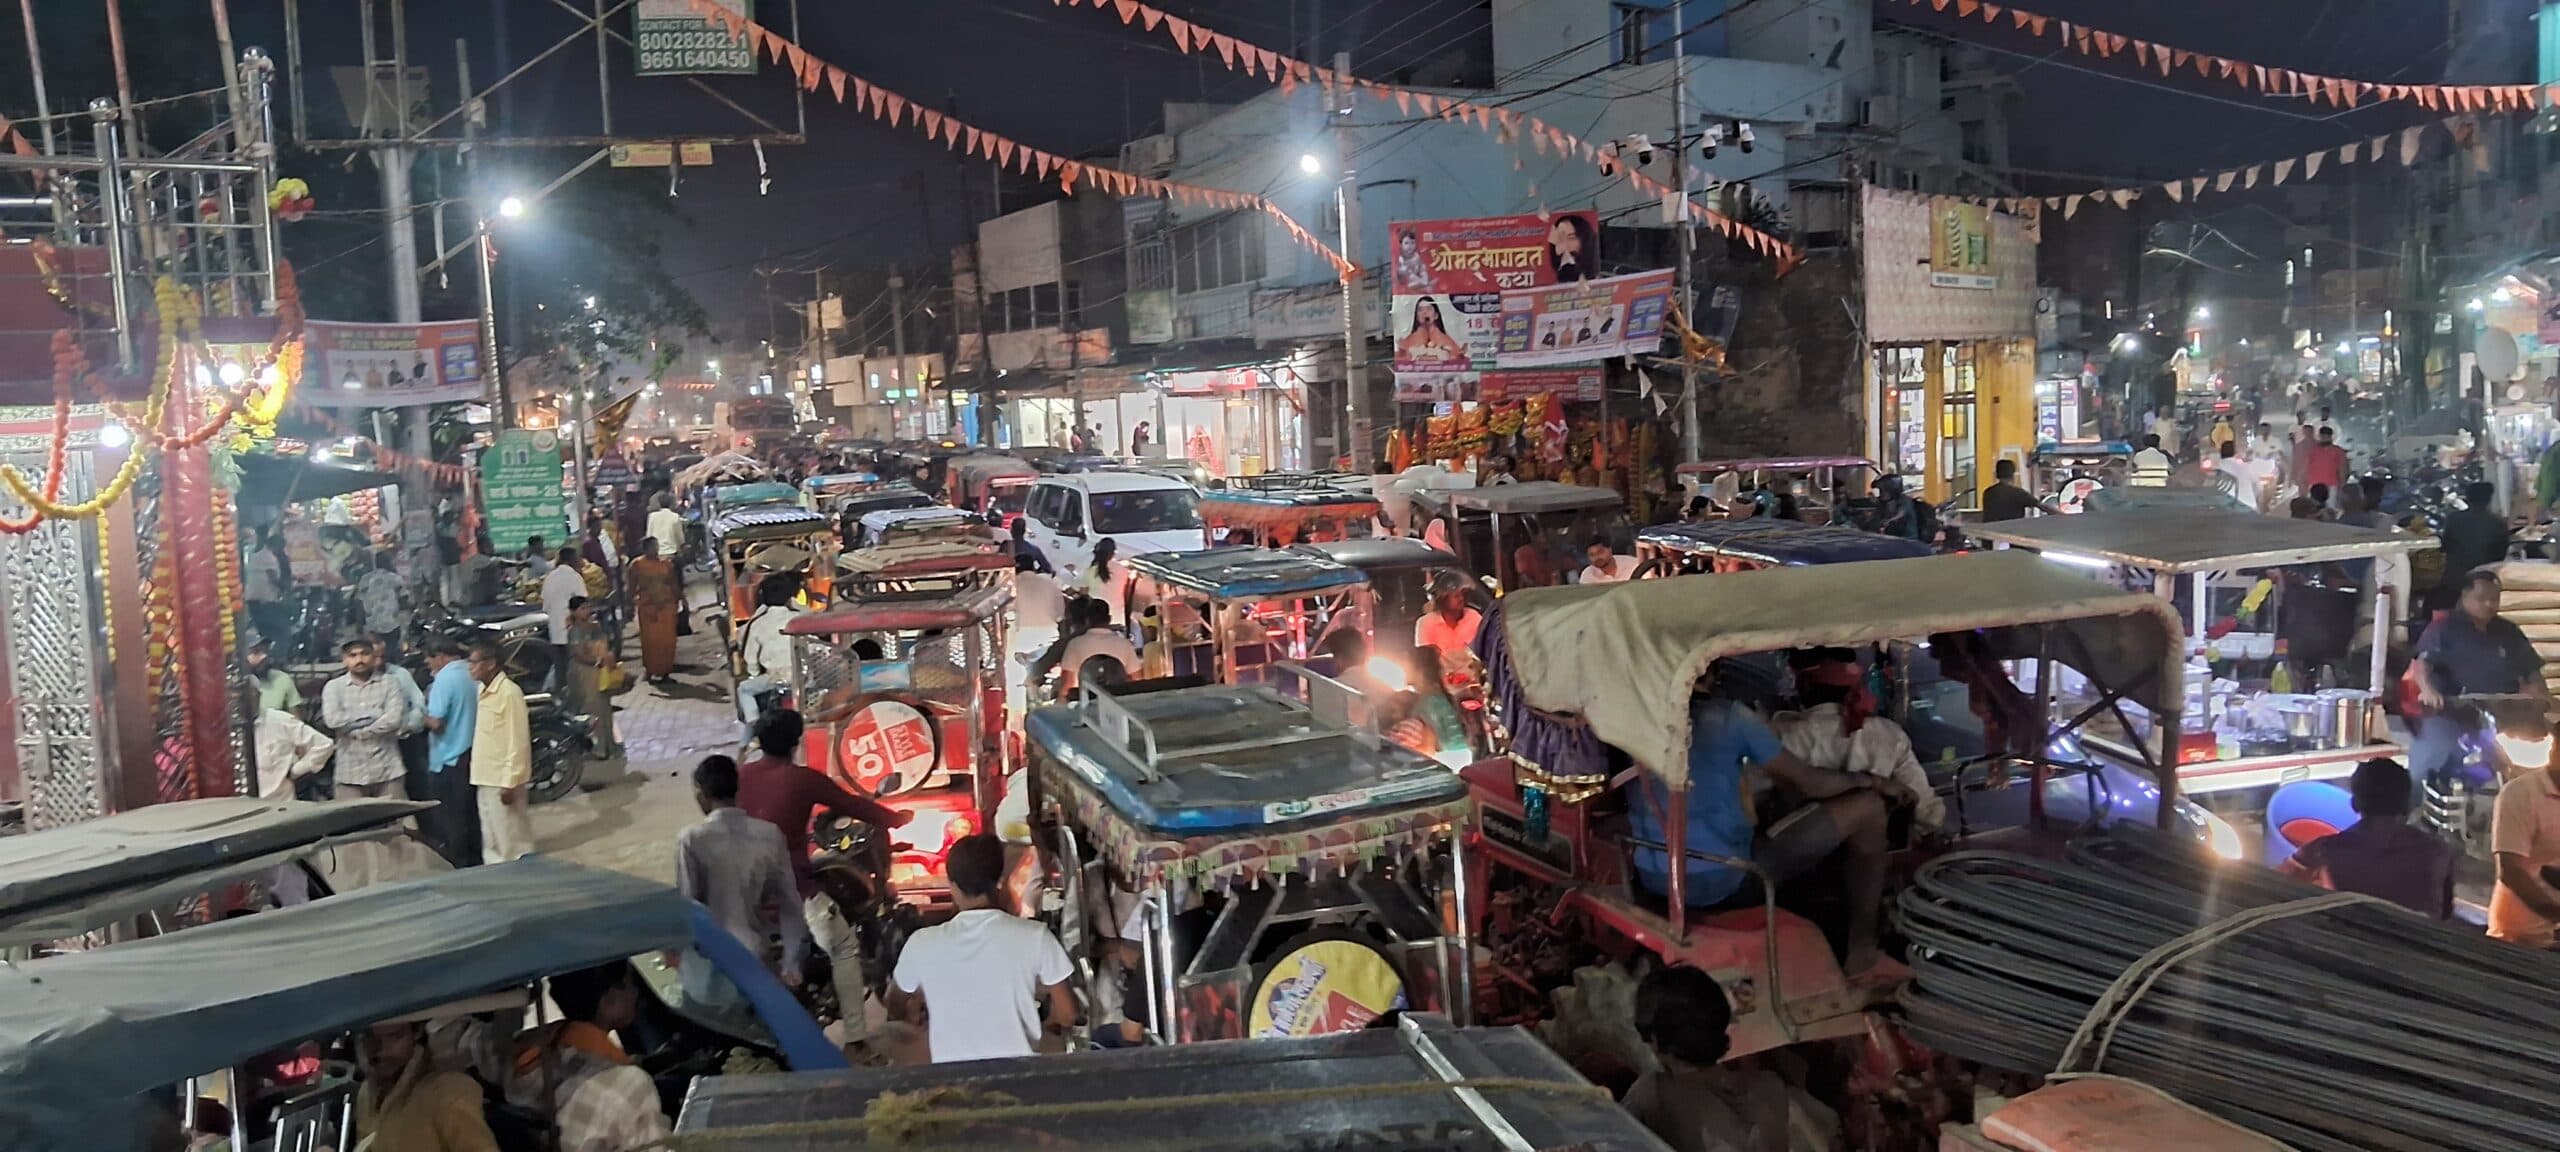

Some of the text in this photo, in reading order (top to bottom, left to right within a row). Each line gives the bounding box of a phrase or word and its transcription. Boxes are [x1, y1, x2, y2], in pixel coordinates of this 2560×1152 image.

[640, 20, 681, 31] CONTACT
[641, 51, 750, 69] 9661640450
[1494, 271, 1535, 288] कथा
